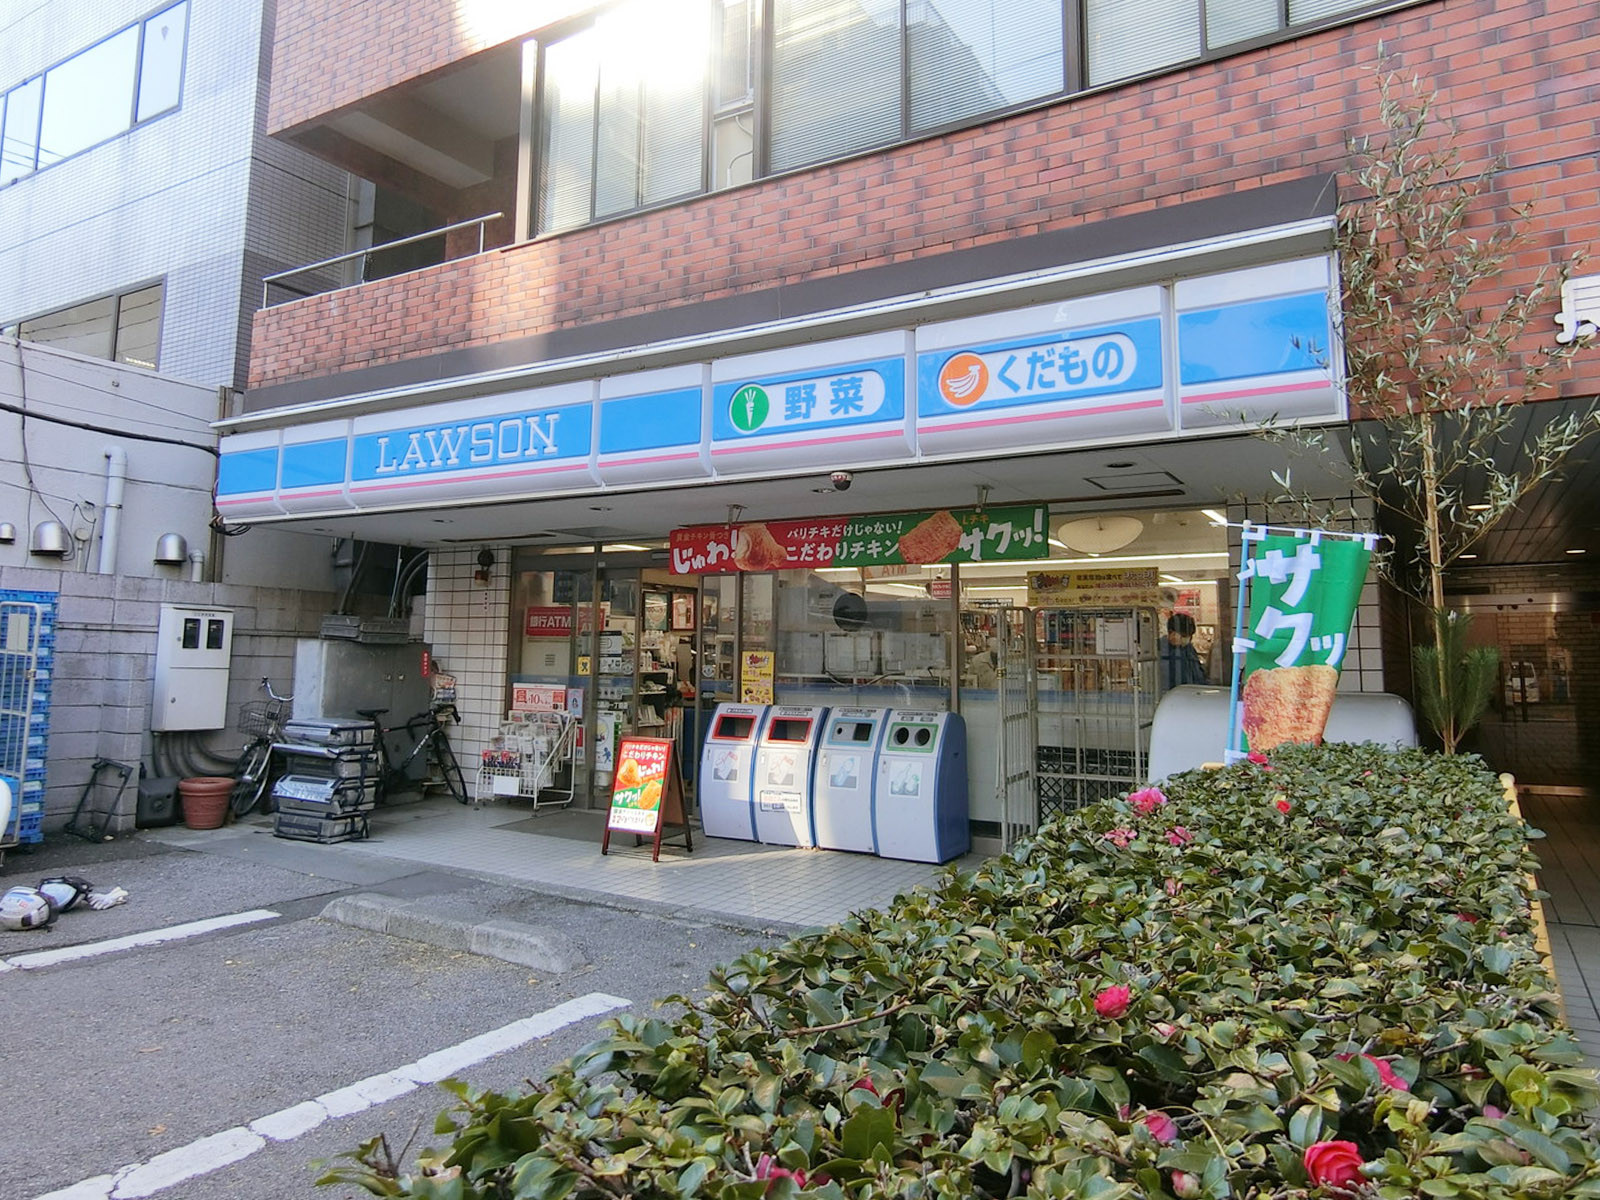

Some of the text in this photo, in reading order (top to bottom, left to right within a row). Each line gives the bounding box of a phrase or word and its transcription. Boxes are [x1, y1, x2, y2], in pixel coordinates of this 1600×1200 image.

[997, 341, 1124, 393] くだもの
[784, 376, 863, 419] 野菜
[376, 413, 560, 473] LAWSON
[786, 540, 899, 561] こだわりチキン
